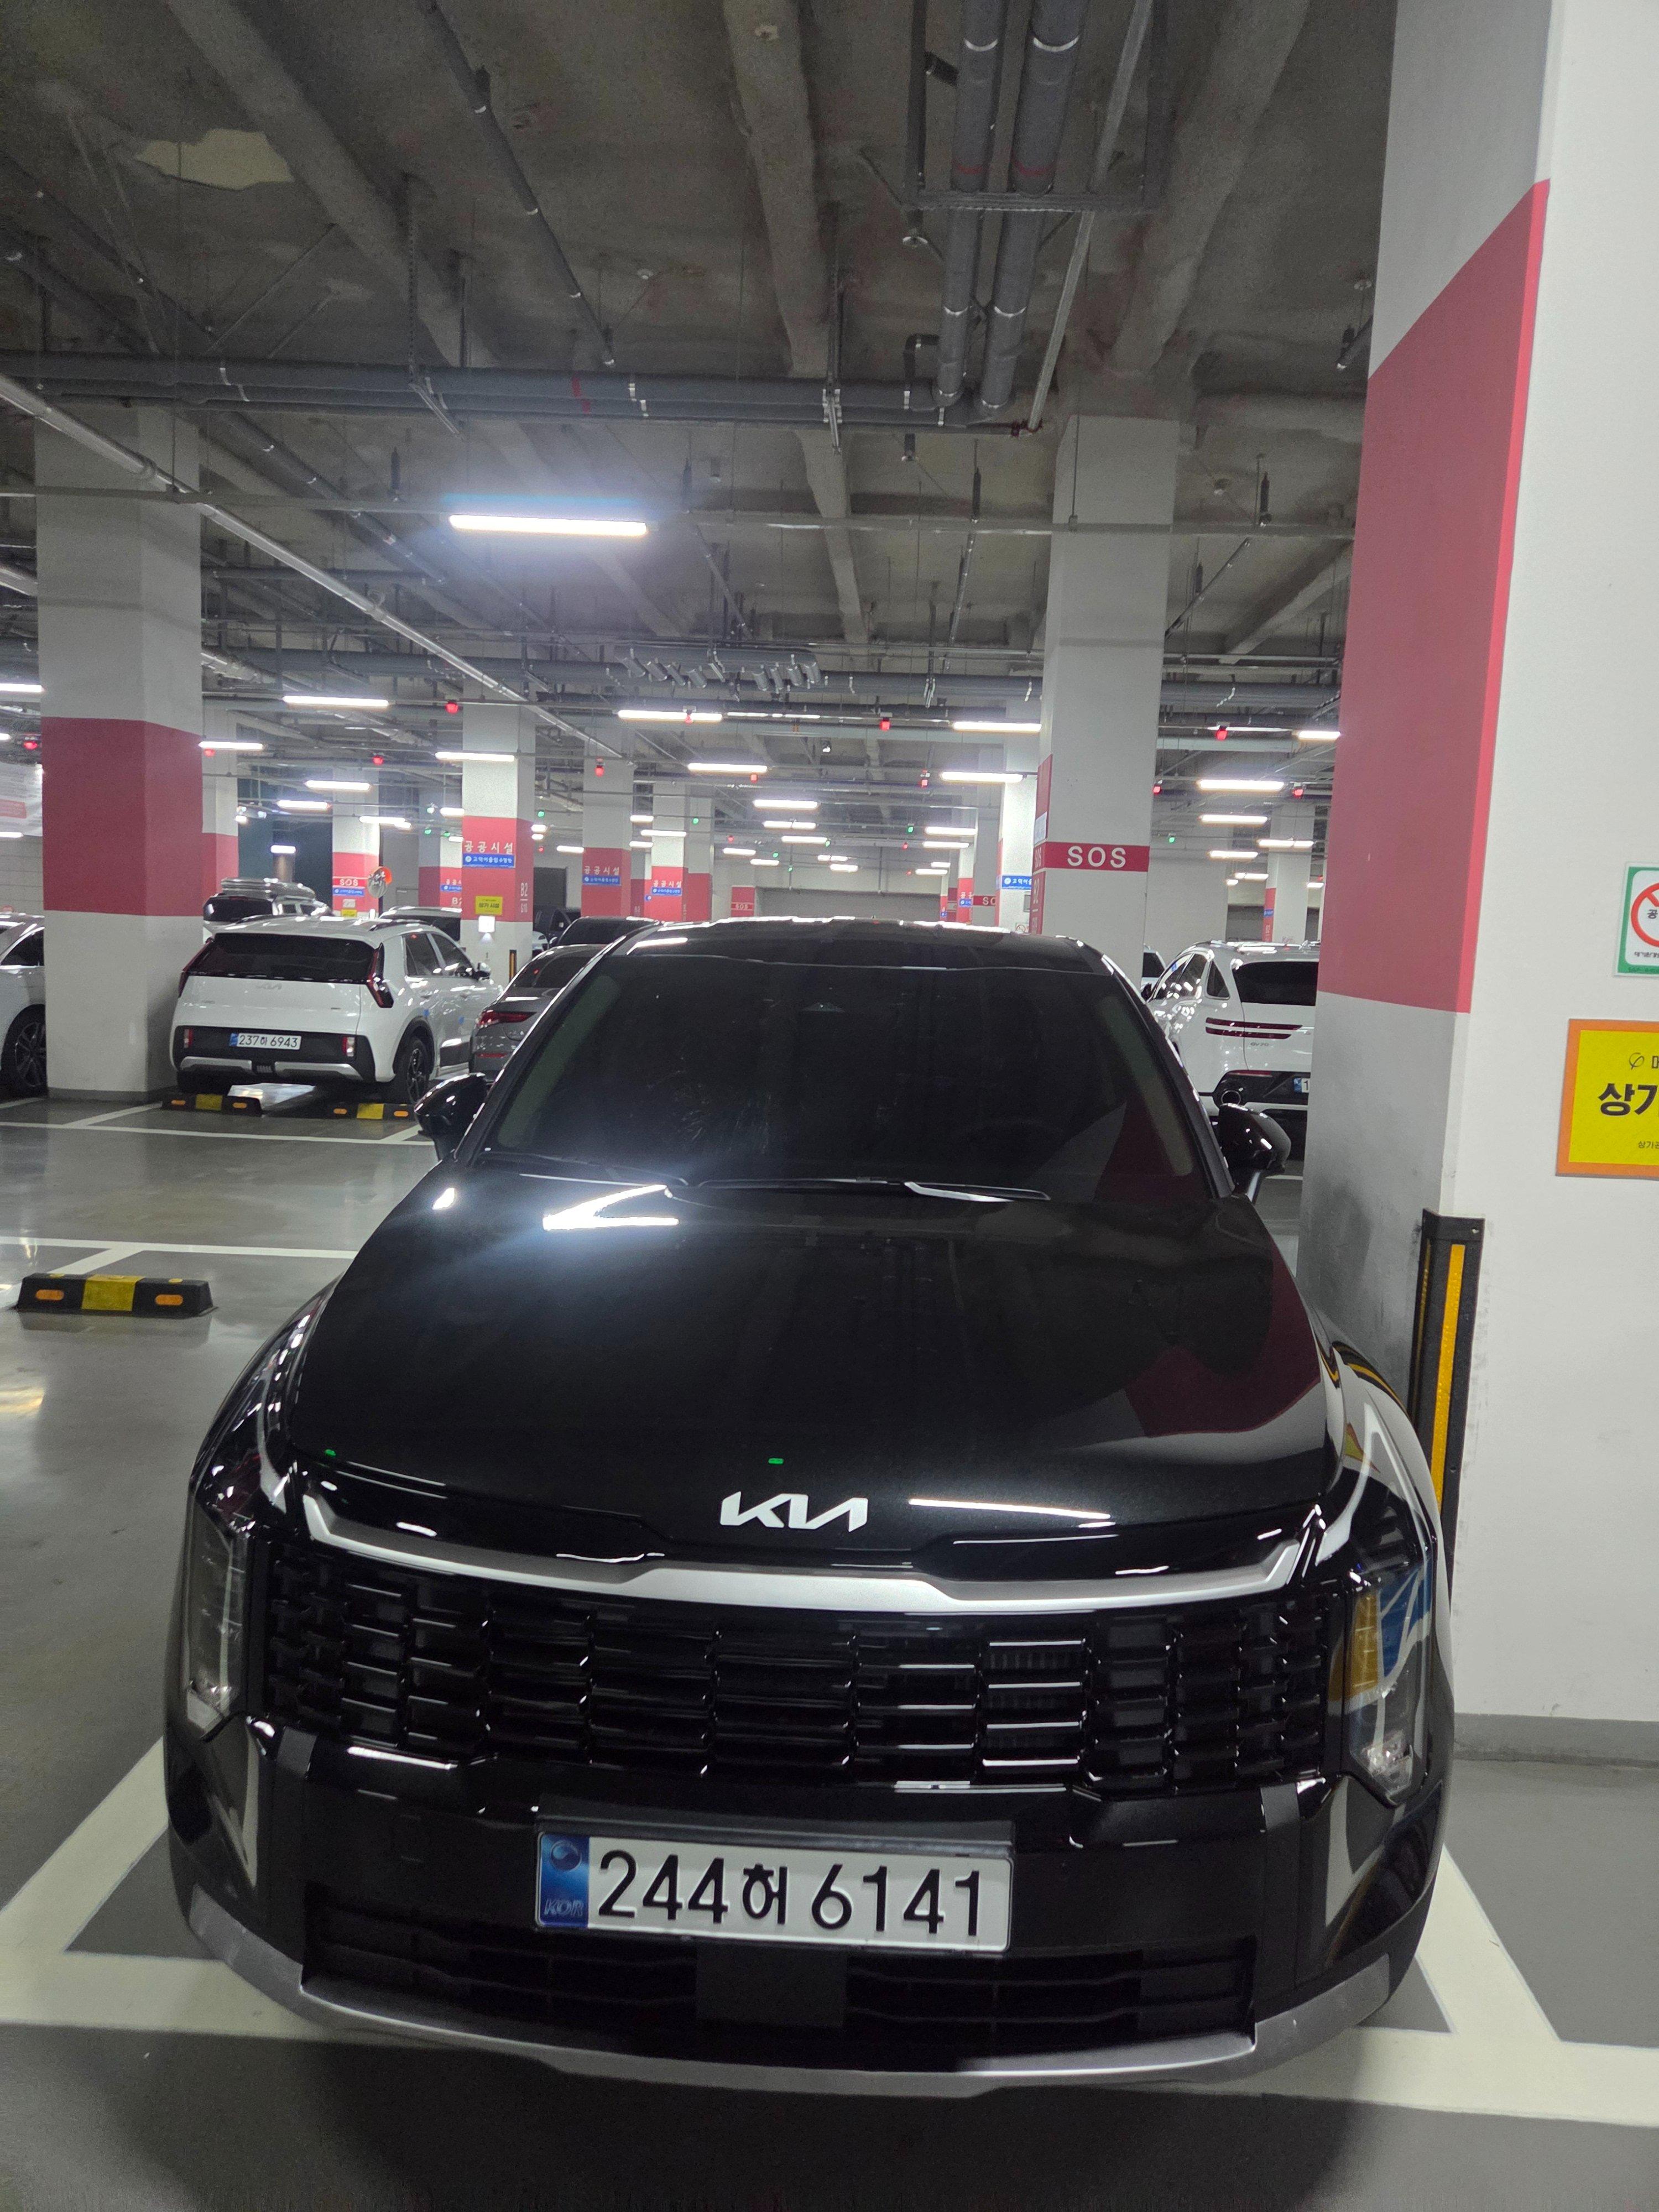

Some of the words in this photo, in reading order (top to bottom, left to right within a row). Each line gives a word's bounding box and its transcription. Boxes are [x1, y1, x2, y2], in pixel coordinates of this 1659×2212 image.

[465, 841, 513, 854] 공공시설
[1067, 846, 1126, 868] SOS
[340, 878, 358, 886] SOS
[520, 882, 528, 897] B2
[982, 896, 996, 905] SO
[270, 1036, 298, 1048] 6943
[720, 1491, 868, 1532] KIA
[598, 1849, 788, 1925] 244허
[811, 1864, 980, 1937] 6141
[544, 1898, 585, 1917] KOR
